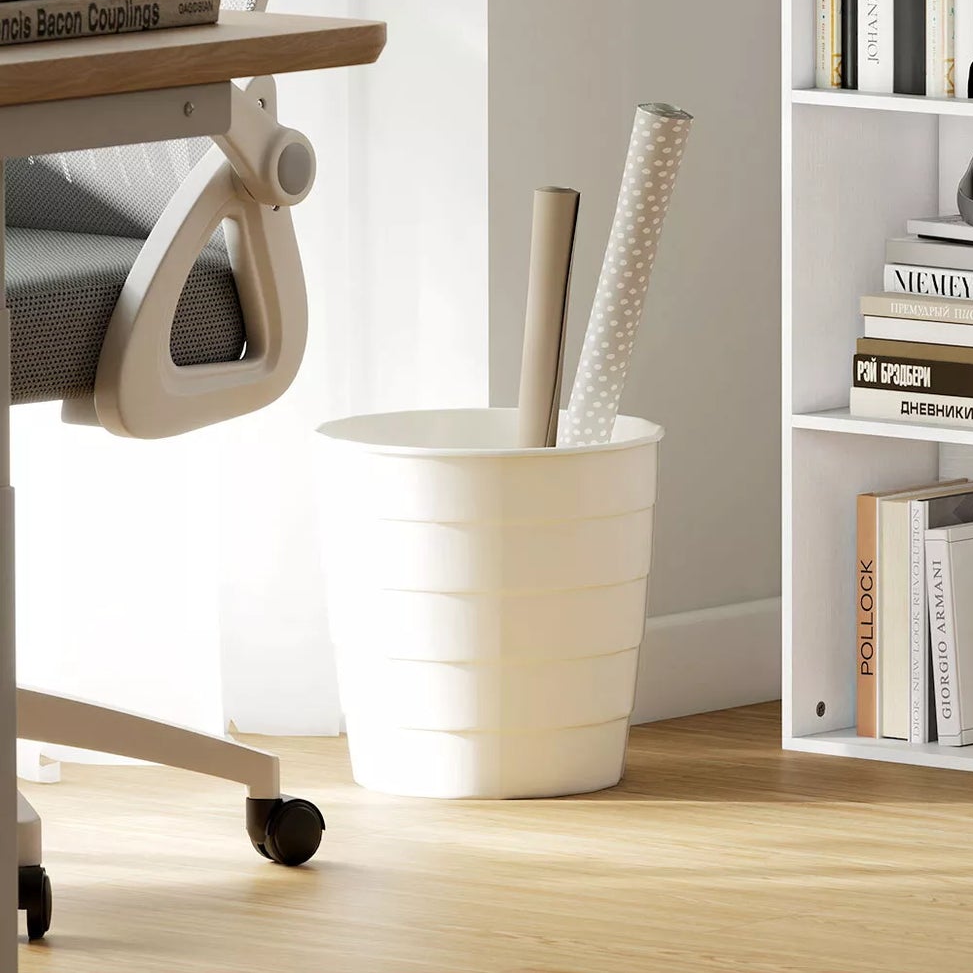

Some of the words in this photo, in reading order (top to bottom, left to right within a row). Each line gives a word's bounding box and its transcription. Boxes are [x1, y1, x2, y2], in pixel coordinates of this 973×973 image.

[0, 10, 32, 41] ncis
[36, 7, 82, 38] Bacon
[890, 302, 950, 319] ПРЕМУДРЫЙ
[857, 357, 877, 383] РЭЙ
[880, 362, 931, 388] БРЭДБЕРИ
[900, 400, 973, 420] ДНЕВНИКИ
[912, 508, 920, 606] REVOLUTION
[932, 560, 947, 634] ARMANI
[860, 559, 874, 676] POLLOCK
[912, 612, 920, 653] LOOK
[912, 658, 920, 692] NEW
[937, 640, 952, 720] GIORGIO
